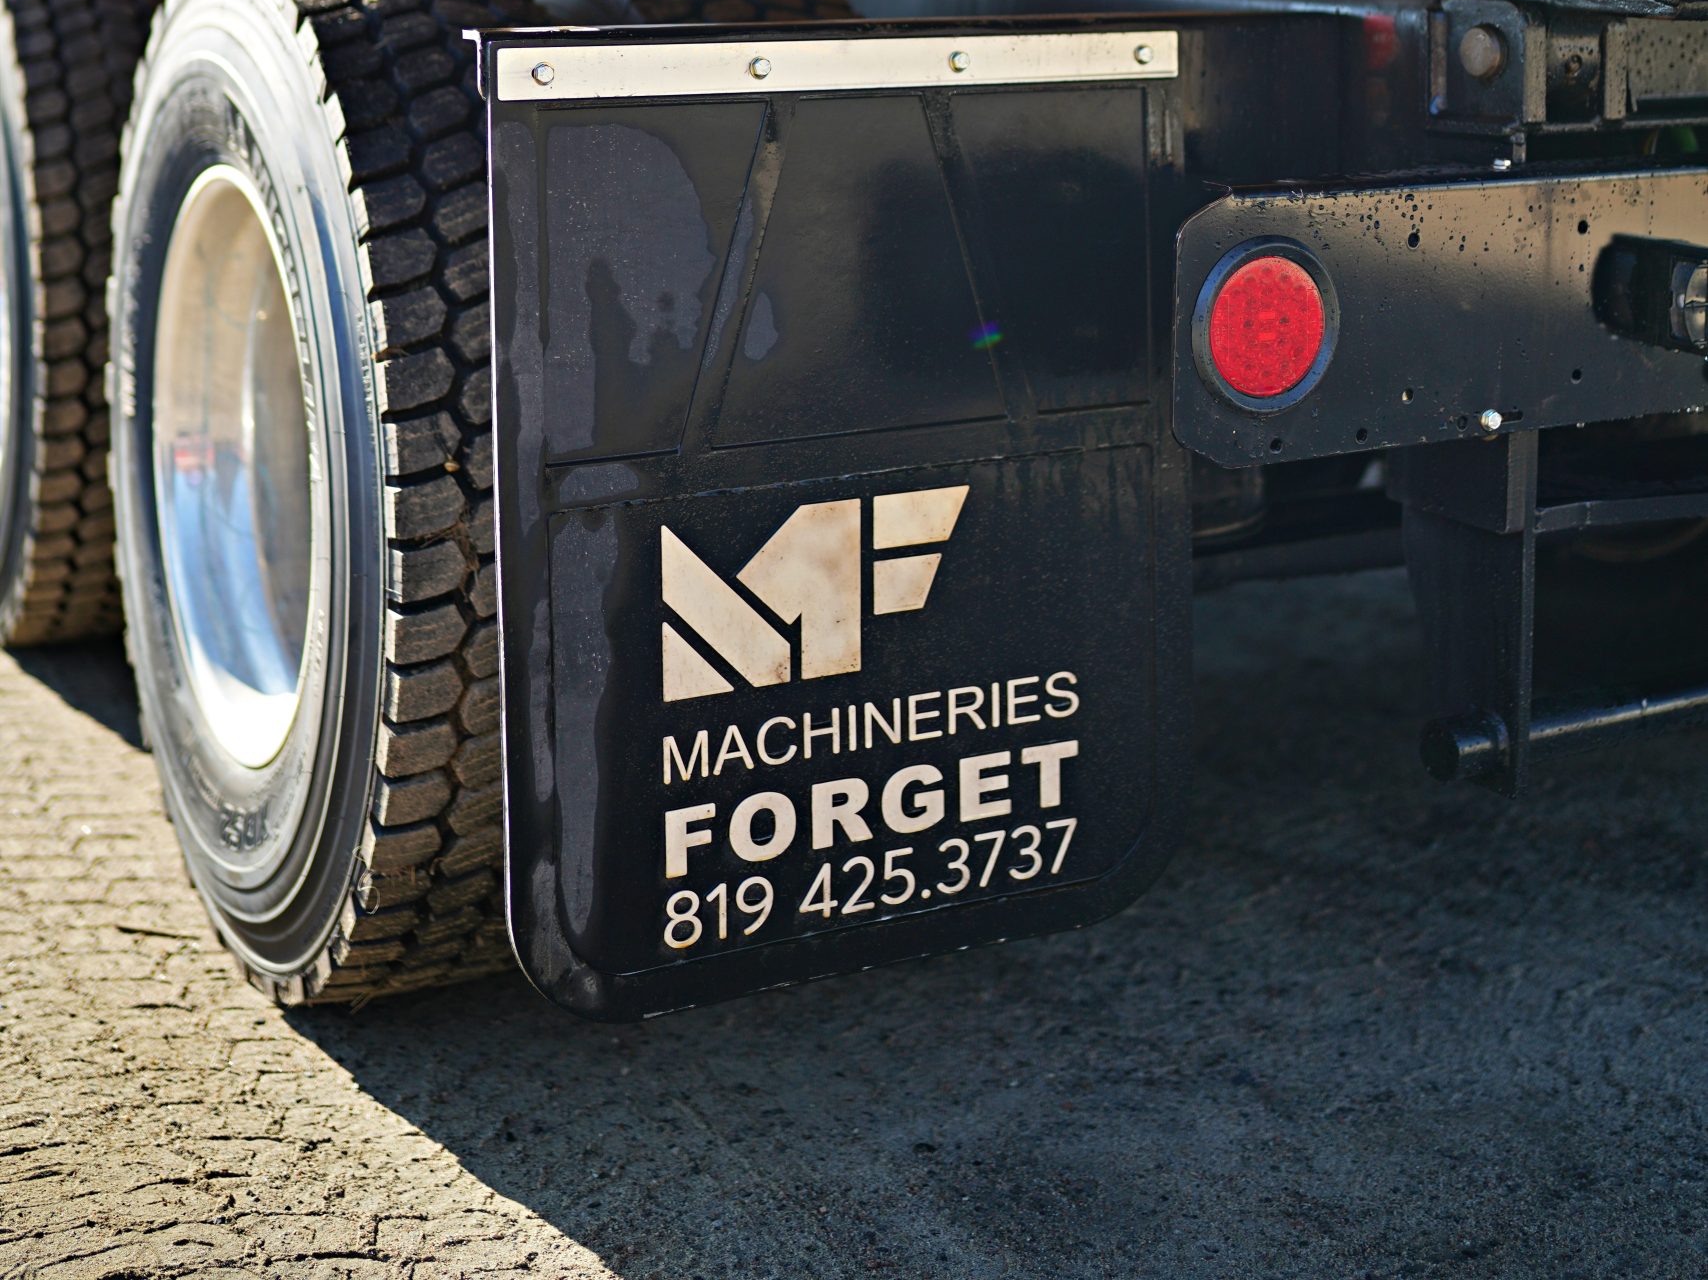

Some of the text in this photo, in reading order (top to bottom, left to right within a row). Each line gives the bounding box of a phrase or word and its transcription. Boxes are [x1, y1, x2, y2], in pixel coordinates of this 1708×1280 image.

[662, 671, 1080, 785] MACHINERIES
[664, 739, 1079, 879] FORGET
[663, 817, 1078, 949] 819 425.3737
